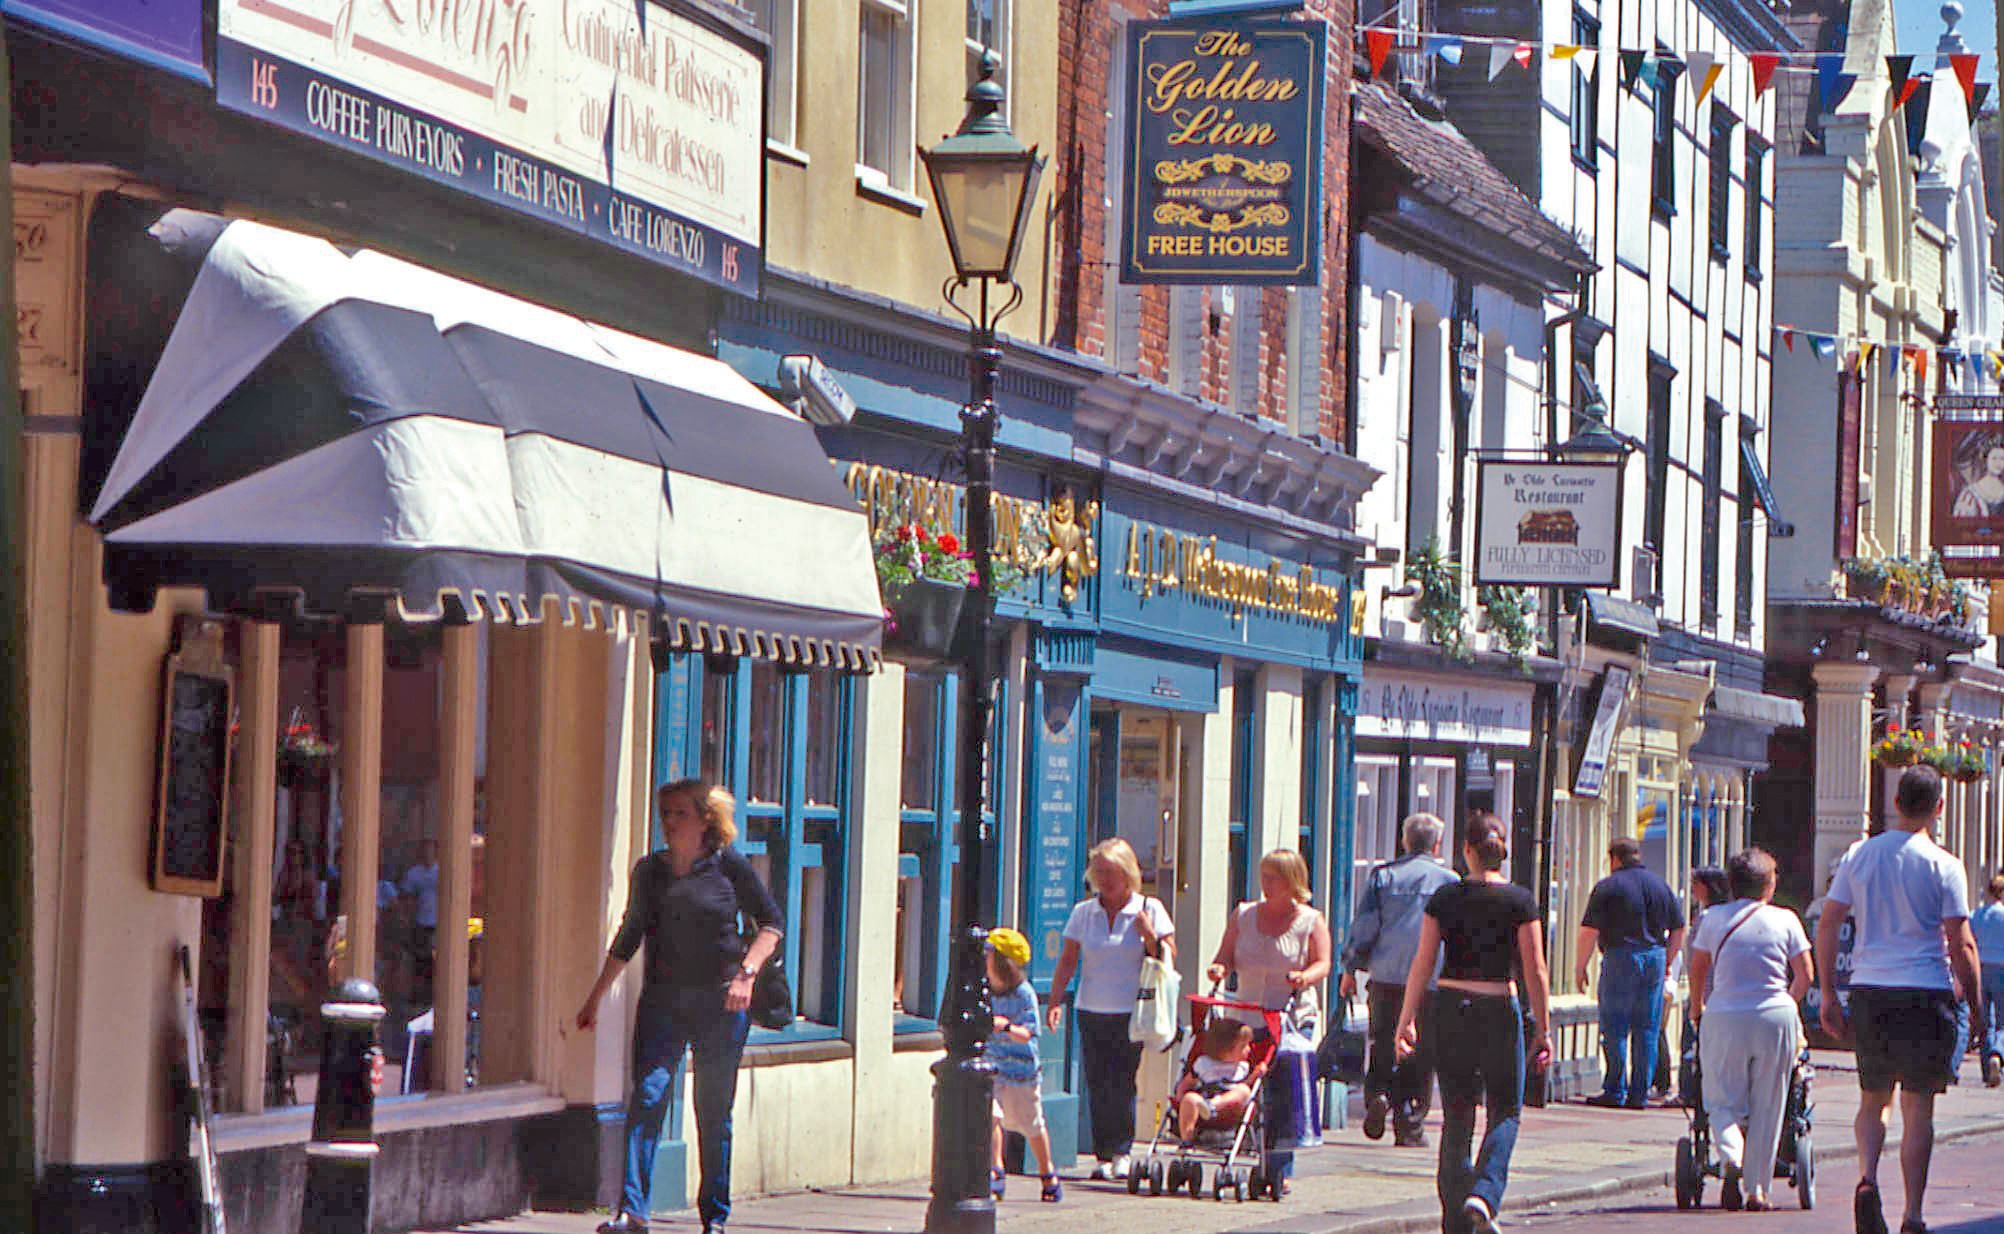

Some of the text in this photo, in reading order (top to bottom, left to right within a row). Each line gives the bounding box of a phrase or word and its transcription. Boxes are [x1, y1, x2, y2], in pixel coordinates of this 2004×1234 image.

[1194, 31, 1253, 57] The
[1147, 60, 1299, 113] Golden
[1167, 105, 1277, 145] Lion
[620, 93, 726, 195] Delicatessen
[251, 58, 278, 110] 145
[306, 79, 371, 144] COFFEE
[375, 105, 464, 176] PURVEYORS
[494, 151, 538, 205] FRESH
[543, 169, 585, 221] PASTA
[608, 196, 643, 245] CAFE
[646, 211, 705, 268] LORENZO
[1147, 236, 1289, 256] FREE HOUSE
[1937, 397, 1974, 409] QUEEN
[1514, 488, 1584, 504] Restaurant
[1488, 547, 1606, 566] FULLY LICENSED
